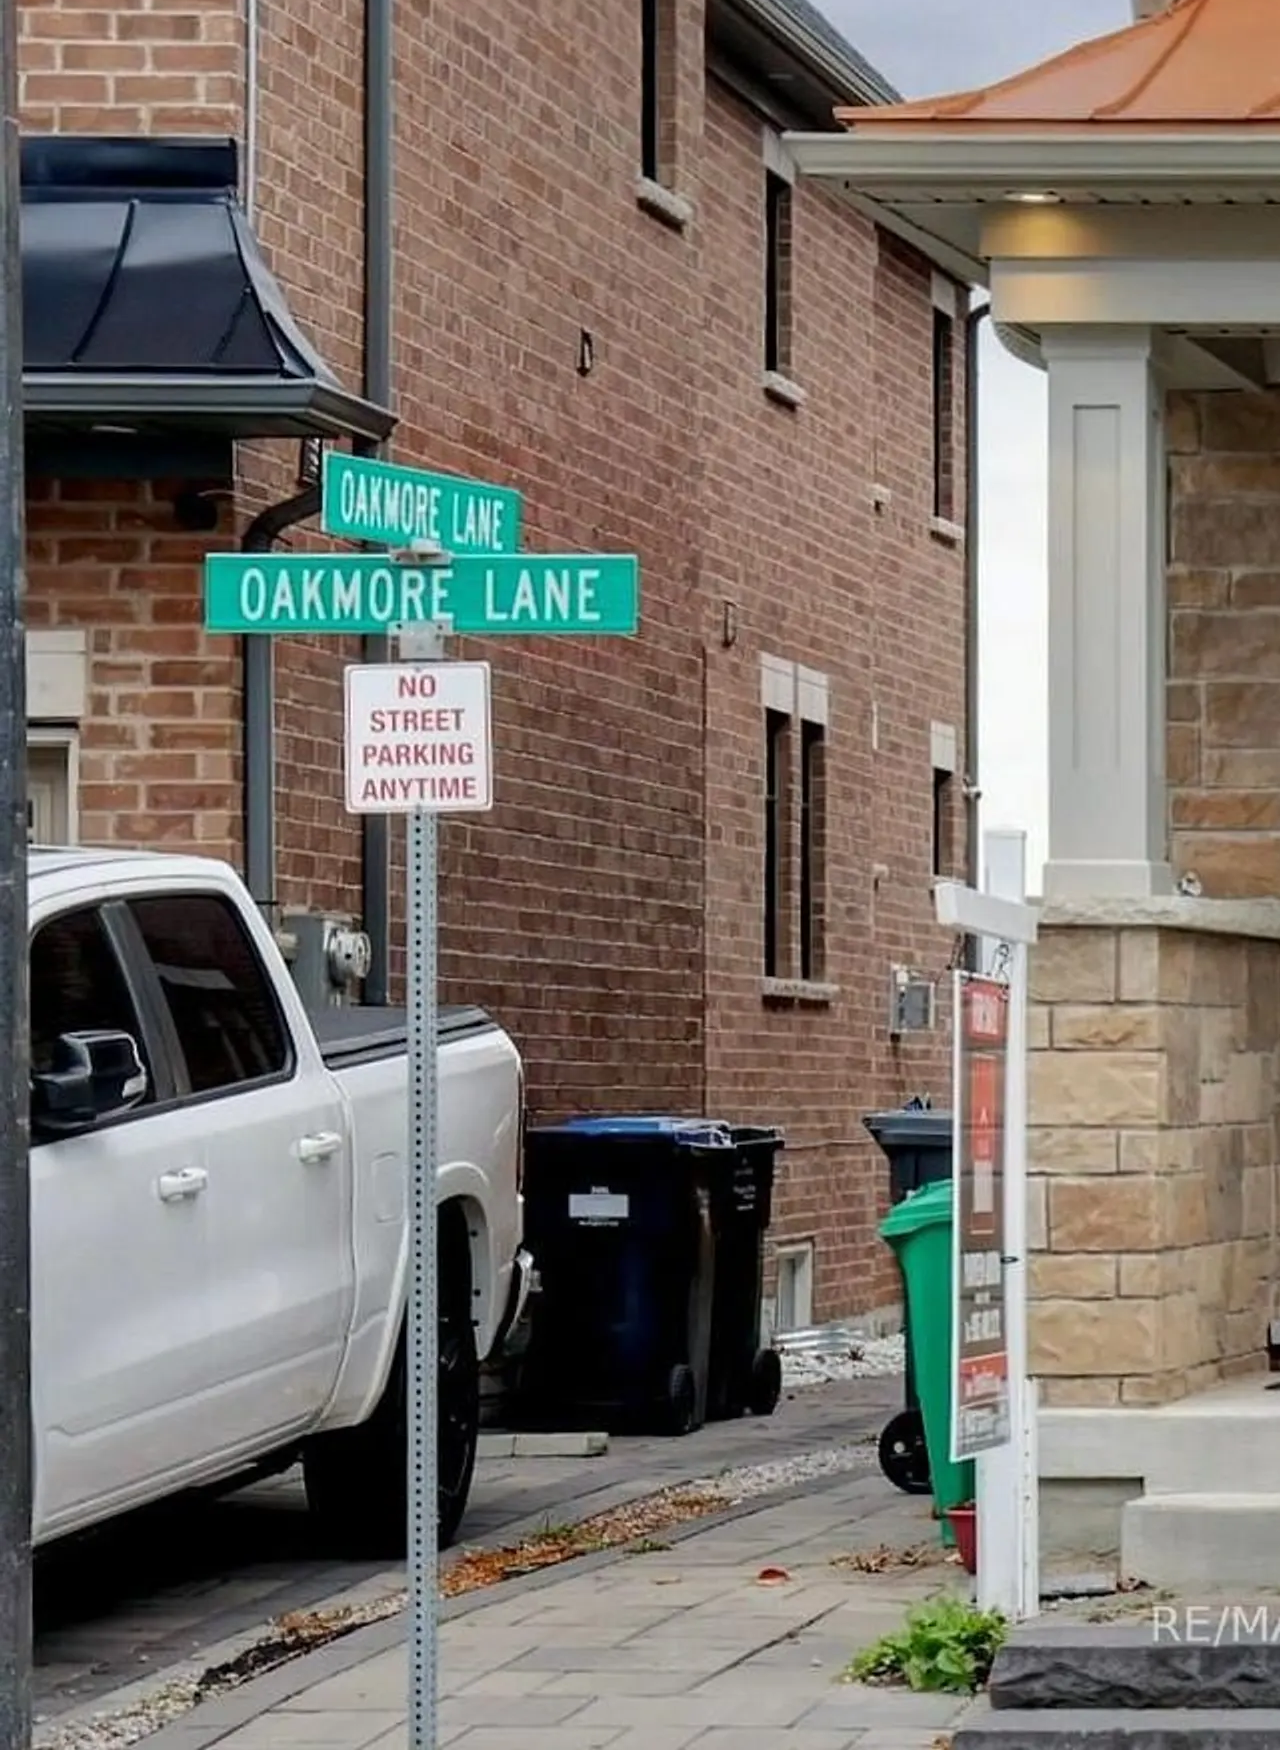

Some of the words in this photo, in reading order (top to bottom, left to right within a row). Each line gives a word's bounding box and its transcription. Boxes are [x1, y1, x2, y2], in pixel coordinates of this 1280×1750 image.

[340, 469, 442, 540] OAKMORE
[453, 492, 505, 550] LANE
[240, 567, 454, 622] OAKMORE
[485, 567, 601, 622] LANE
[398, 674, 436, 698] NO
[370, 709, 465, 732] STREET
[362, 743, 474, 766] PARKING
[361, 777, 477, 801] ANYTIME
